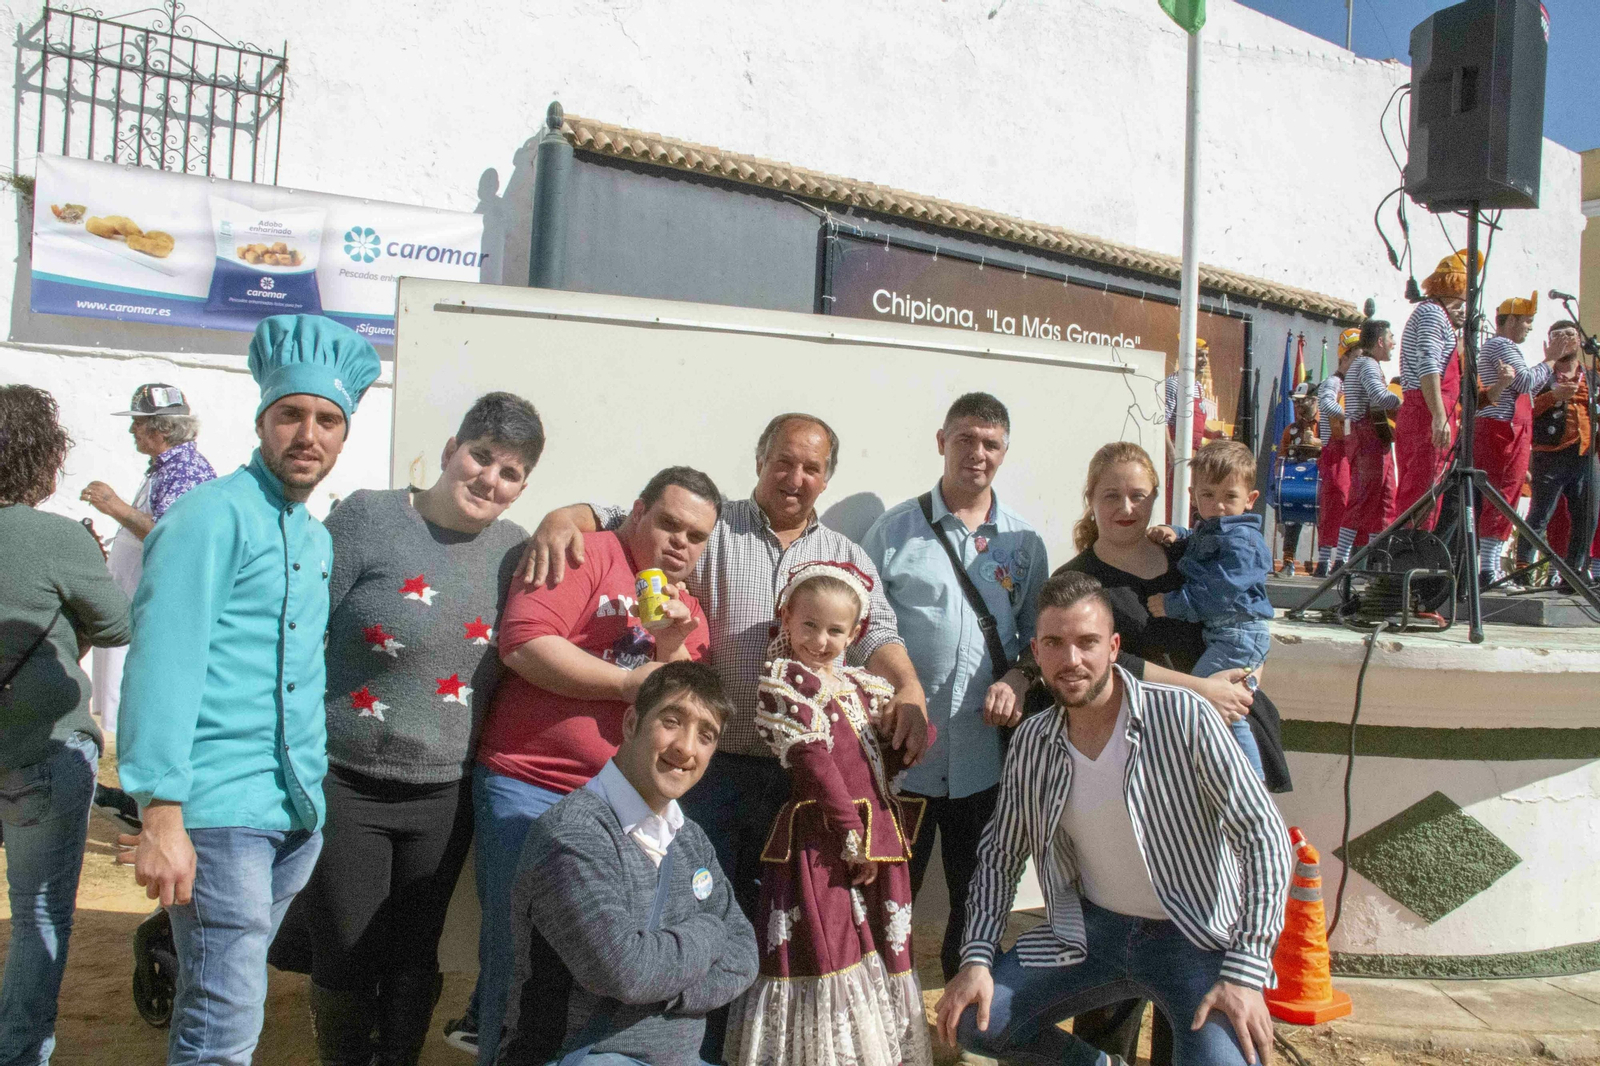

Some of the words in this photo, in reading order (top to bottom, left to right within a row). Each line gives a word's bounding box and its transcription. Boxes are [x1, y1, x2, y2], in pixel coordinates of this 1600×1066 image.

[249, 226, 292, 235] enharinado
[258, 220, 283, 228] Adobo
[386, 242, 489, 267] caromar
[339, 268, 379, 281] Pescados
[246, 289, 287, 299] caromar
[76, 300, 171, 317] www.caromar.es
[872, 289, 979, 331] Chipiona,
[986, 309, 1016, 335] "La
[1022, 315, 1061, 342] Más
[1067, 324, 1141, 349] Grande"
